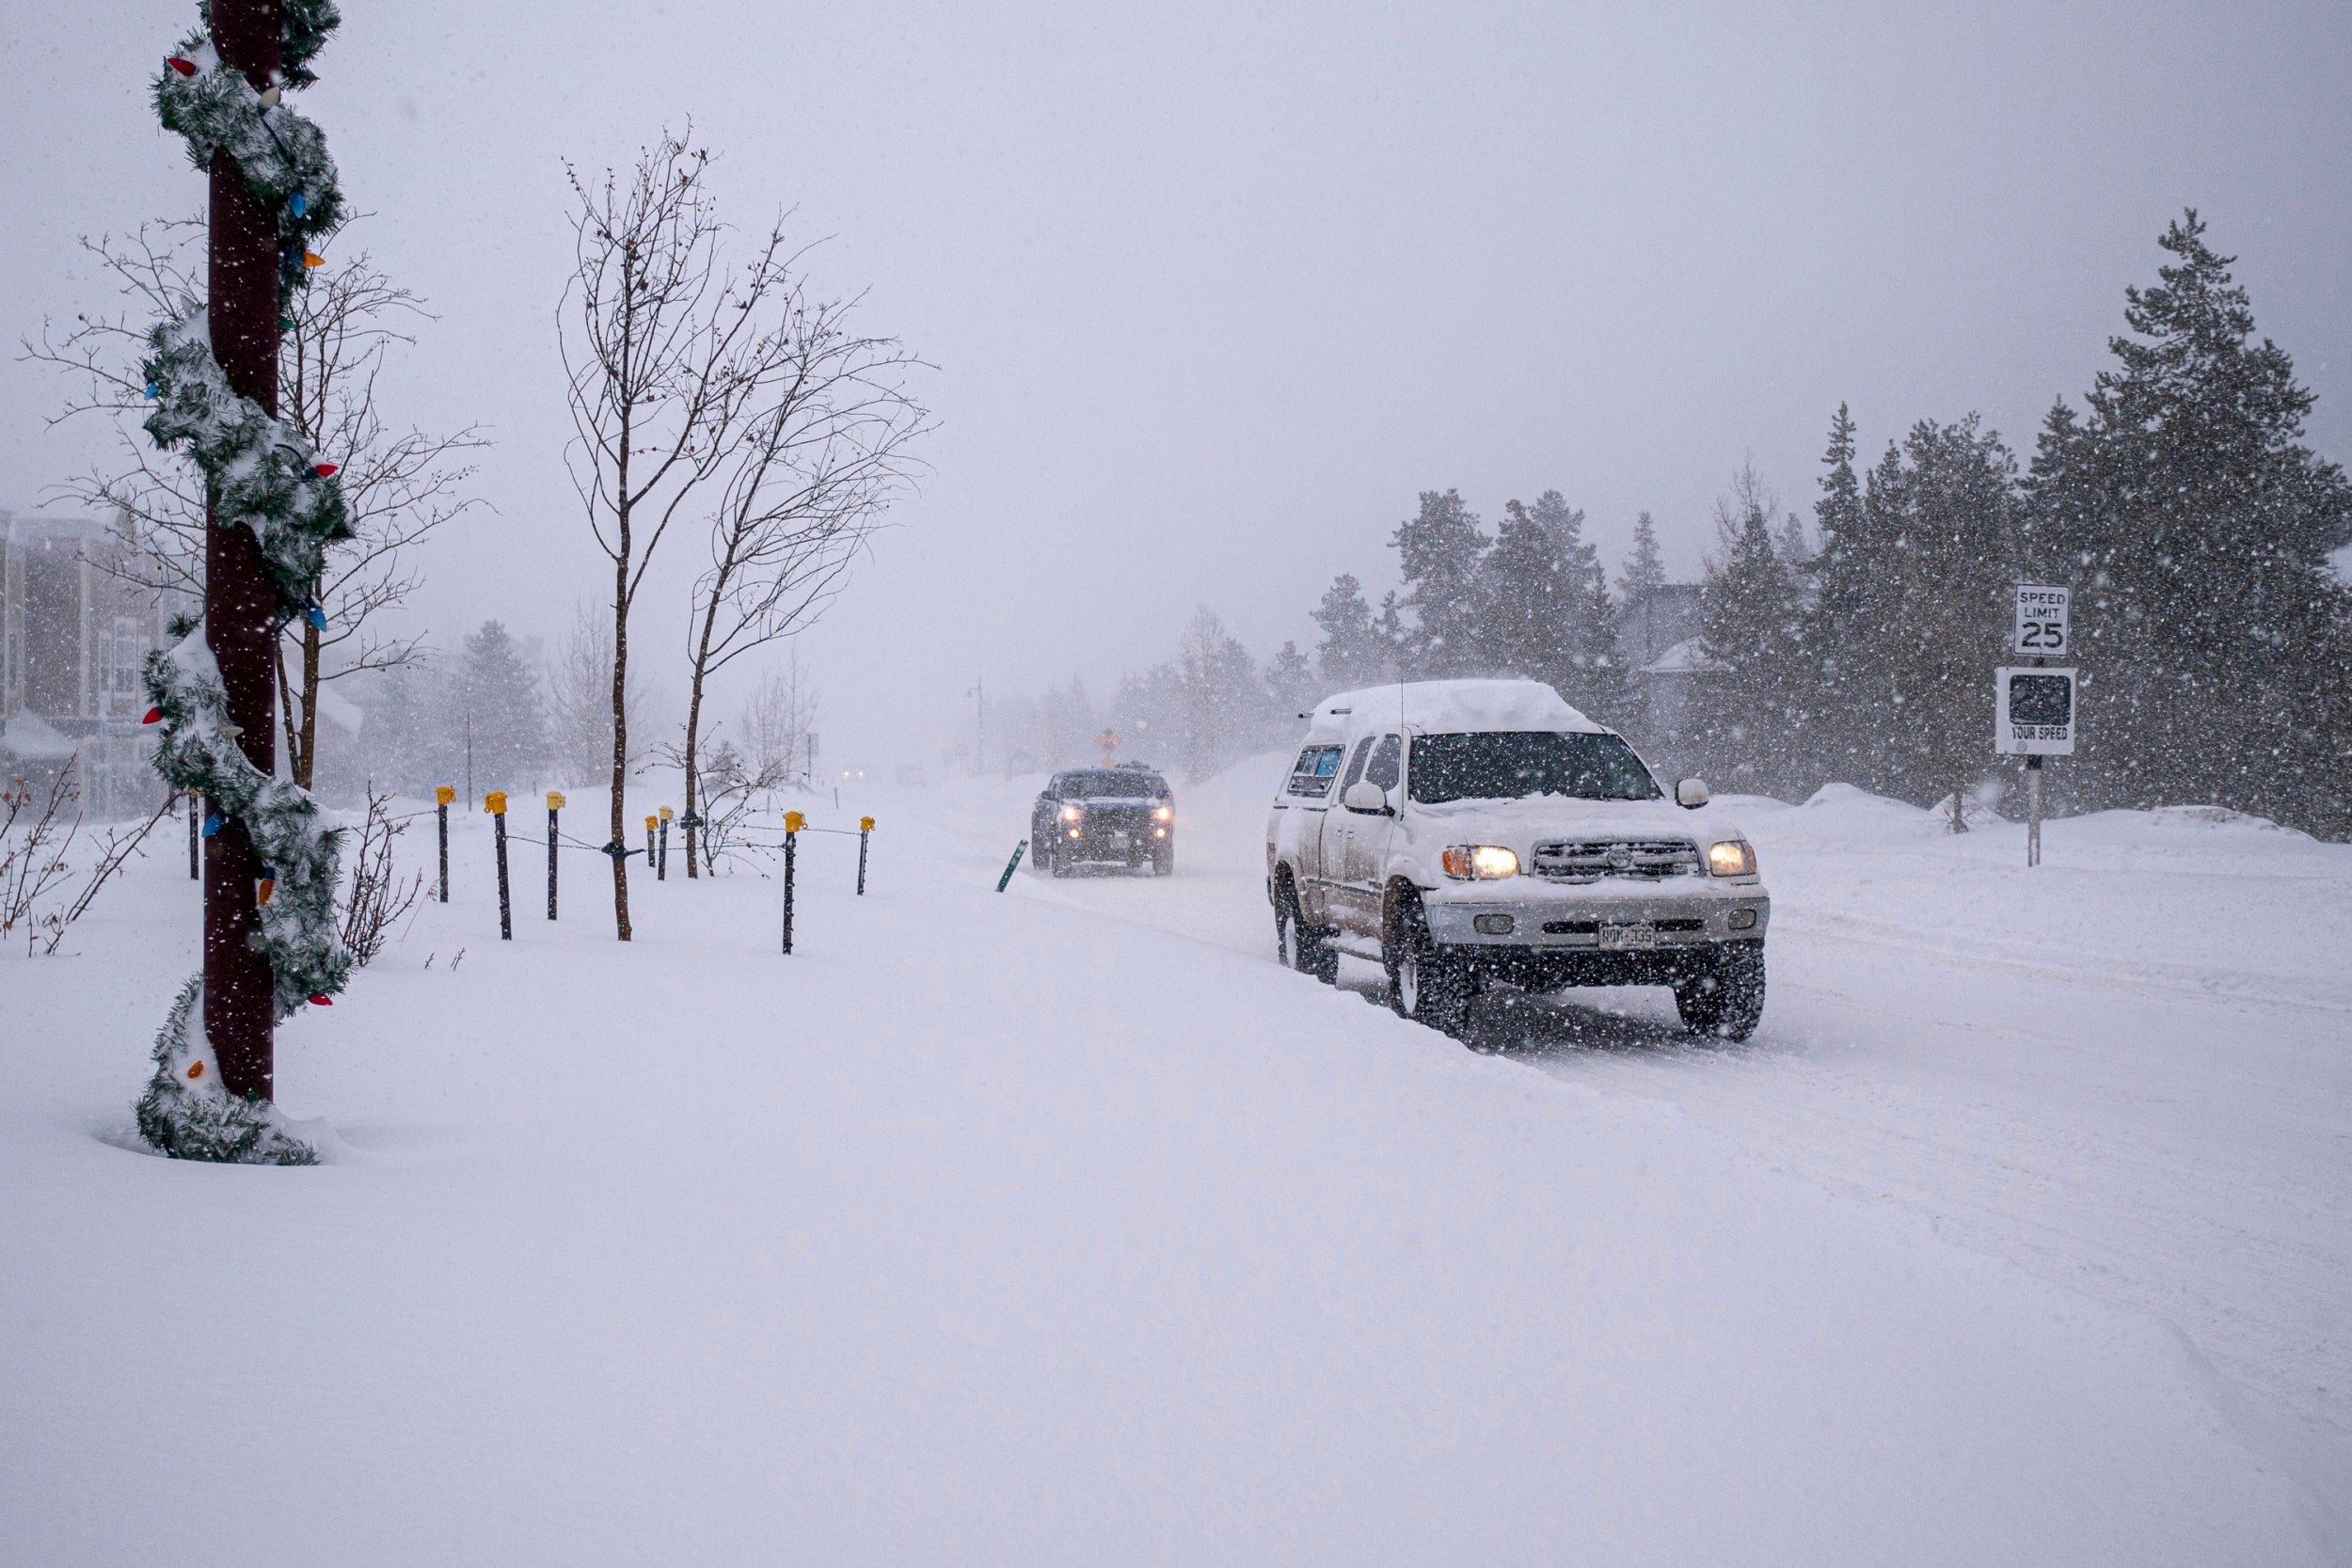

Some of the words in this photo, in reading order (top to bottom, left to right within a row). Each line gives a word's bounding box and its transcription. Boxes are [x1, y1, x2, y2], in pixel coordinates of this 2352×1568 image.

[2020, 593, 2065, 605] SPEED
[2025, 608, 2059, 618] LIMIT
[2021, 622, 2063, 648] 25
[2012, 726, 2036, 739] YOUR
[2038, 727, 2068, 740] SPEED
